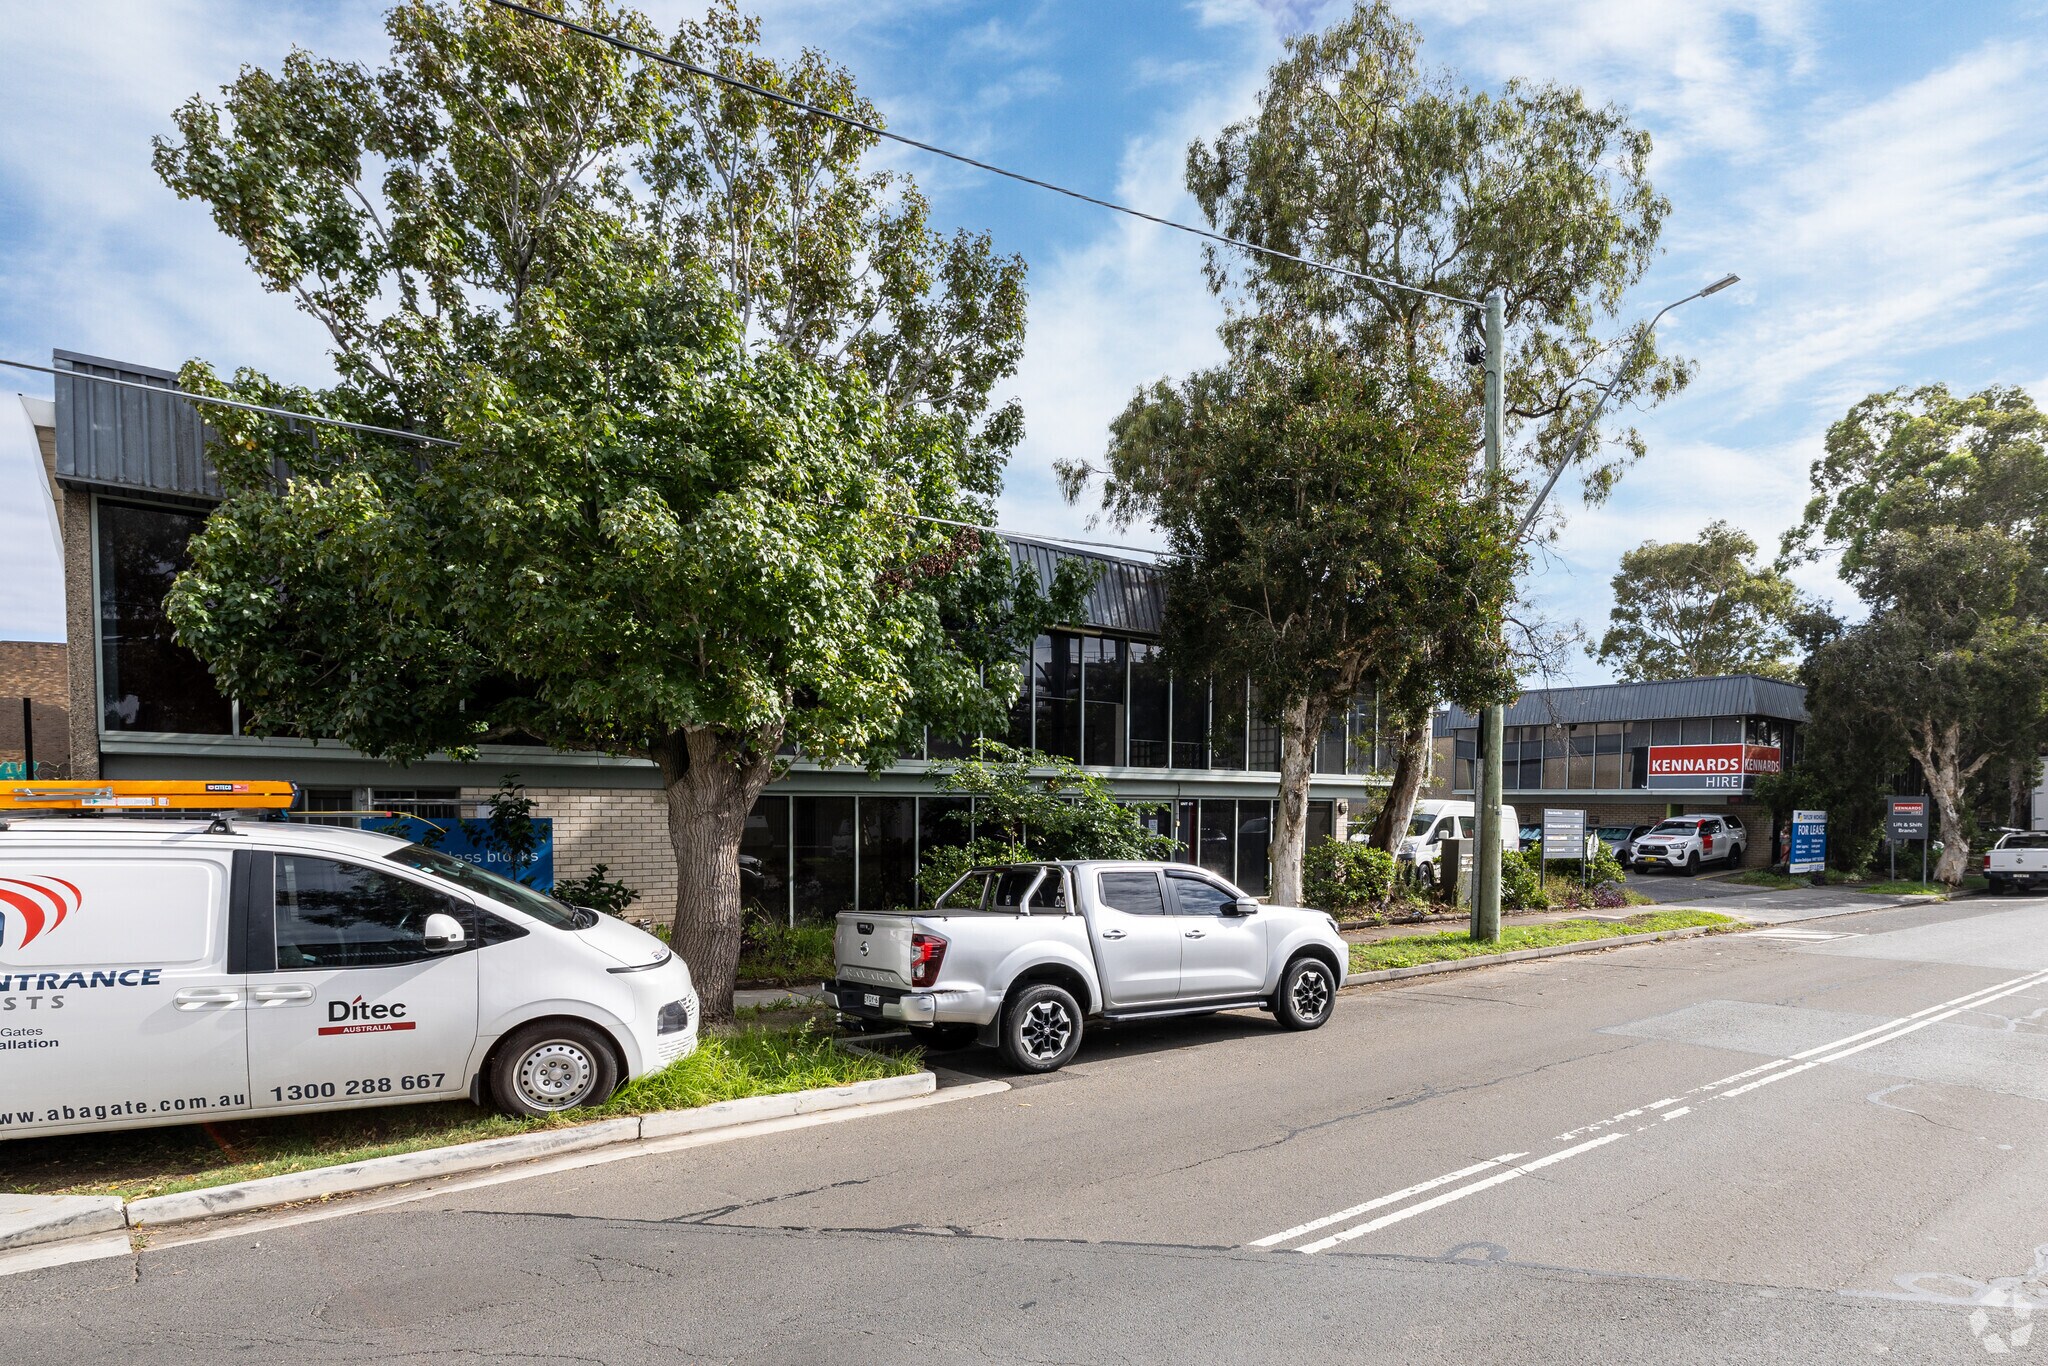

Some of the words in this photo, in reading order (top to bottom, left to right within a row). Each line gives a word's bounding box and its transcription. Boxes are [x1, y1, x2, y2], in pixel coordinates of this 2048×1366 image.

[1652, 758, 1739, 772] KENNARDS
[1744, 758, 1779, 772] KENNARDS
[1706, 776, 1738, 788] HIRE
[1798, 825, 1809, 836] FOR
[1810, 825, 1825, 835] LEASE
[487, 850, 539, 863] bloks
[0, 1027, 43, 1037] Gates
[343, 1024, 393, 1034] AUSTRALIA
[0, 1039, 59, 1050] allation
[270, 1082, 336, 1102] 1300
[345, 1077, 392, 1096] 288
[401, 1073, 446, 1090] 667
